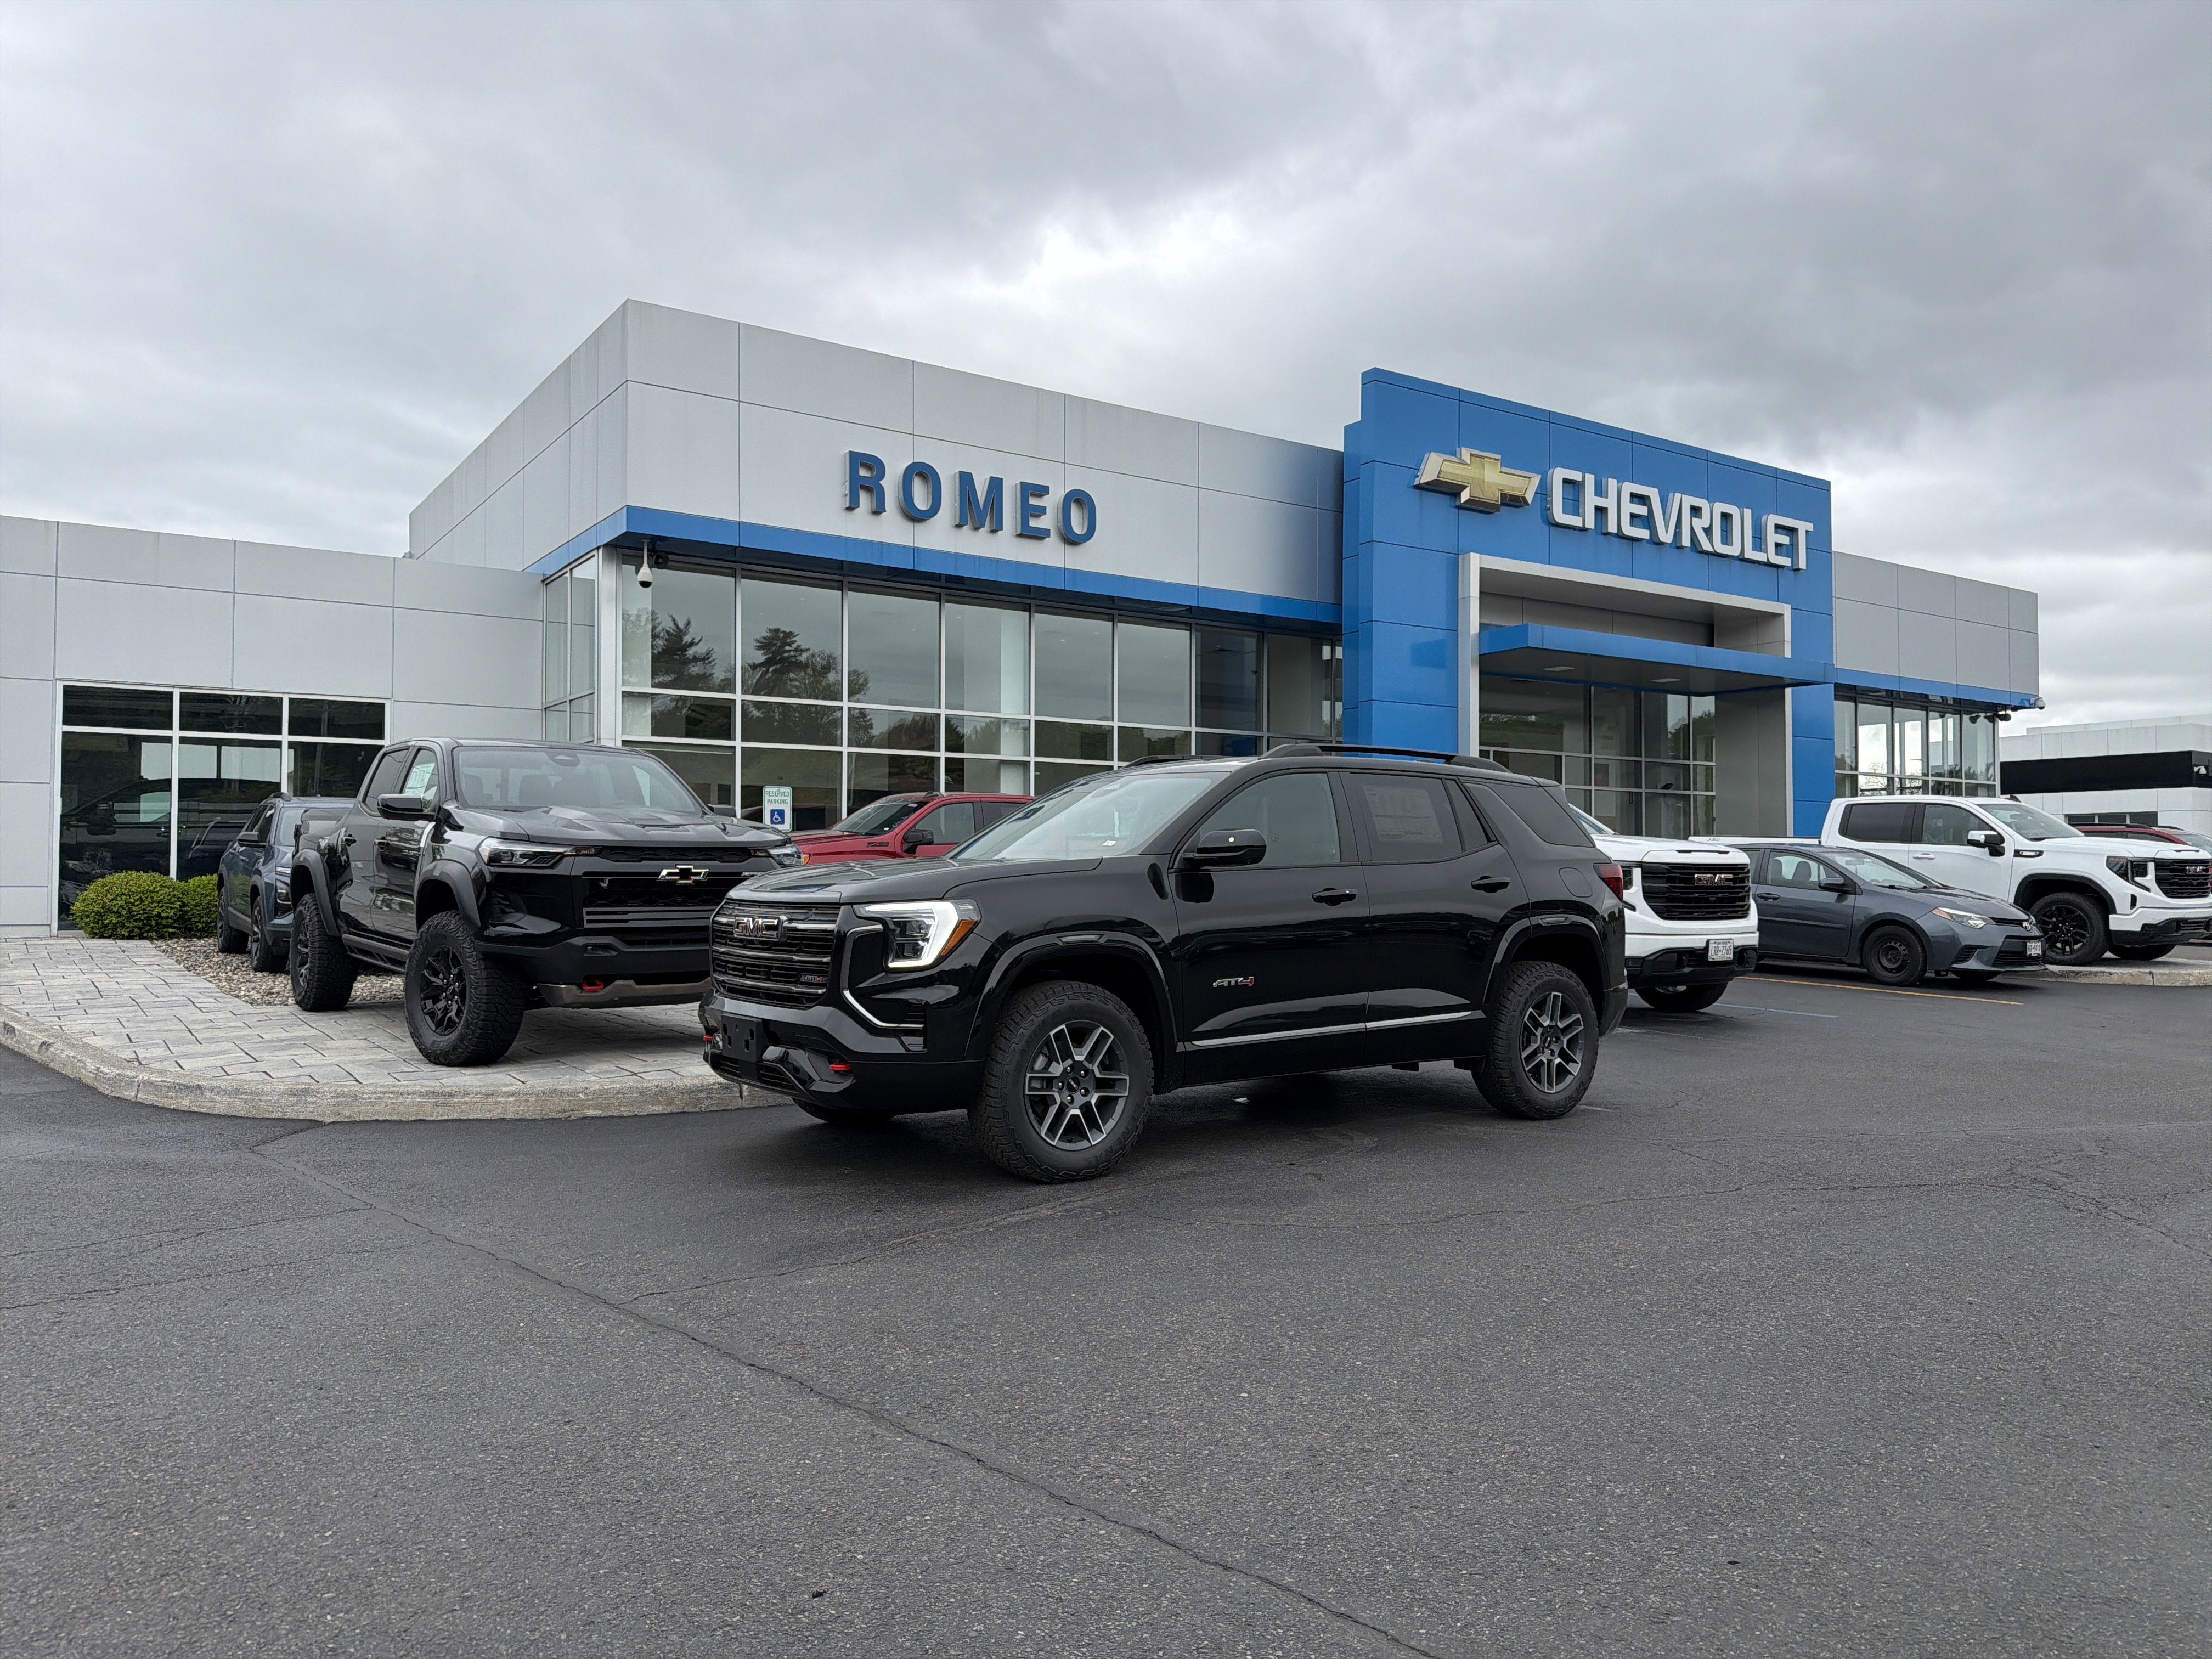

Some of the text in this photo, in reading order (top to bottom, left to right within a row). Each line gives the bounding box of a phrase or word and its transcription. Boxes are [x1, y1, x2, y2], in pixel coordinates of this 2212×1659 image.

[844, 450, 1097, 545] ROMEO
[1547, 467, 1814, 571] CHEVROLET
[1694, 874, 1734, 886] GMC
[734, 917, 778, 939] GMC
[1212, 976, 1255, 988] AT4
